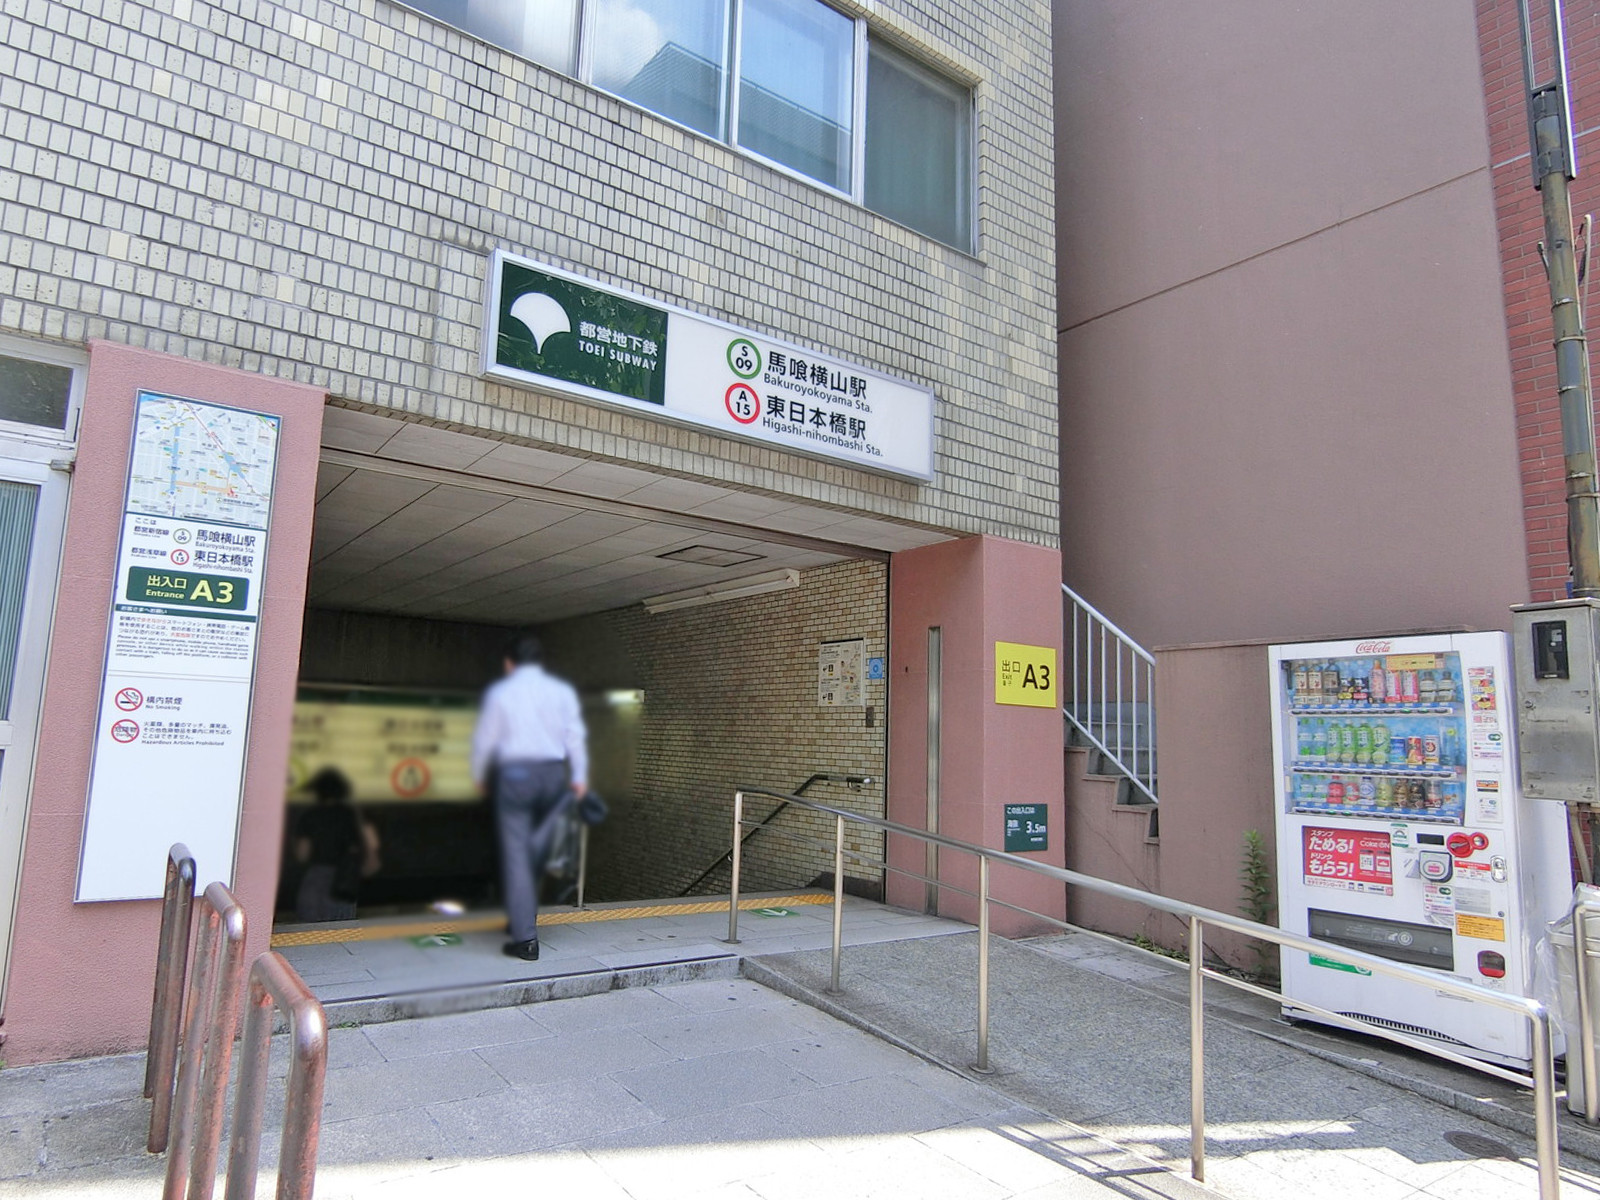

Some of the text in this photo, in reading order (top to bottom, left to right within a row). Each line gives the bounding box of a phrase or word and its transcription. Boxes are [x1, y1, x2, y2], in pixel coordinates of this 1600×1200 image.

[579, 321, 658, 357] 都営地下鉄
[579, 340, 657, 371] TOEI SUBWAY
[741, 345, 749, 357] S
[735, 356, 753, 371] 09
[768, 350, 867, 400] 馬喰横山駅
[738, 390, 748, 402] A
[764, 372, 873, 414] Bakuroyokoyama Sta.
[735, 402, 751, 416] 15
[766, 395, 867, 441] 東日本橋駅
[762, 416, 884, 457] Higashi-nihombashi Sta.
[135, 517, 157, 526] ここは
[196, 529, 256, 547] 馬喰横山駅
[194, 550, 254, 567] 東日本橋駅
[146, 574, 187, 590] 出入口
[146, 589, 185, 600] Entrance
[189, 578, 234, 604] A3
[1002, 660, 1020, 673] 出口
[1022, 663, 1050, 691] A3
[146, 696, 183, 705] 構内禁煙
[1026, 820, 1047, 834] 3.5m
[1311, 829, 1335, 838] スタンプ
[1310, 852, 1334, 861] ドリンク
